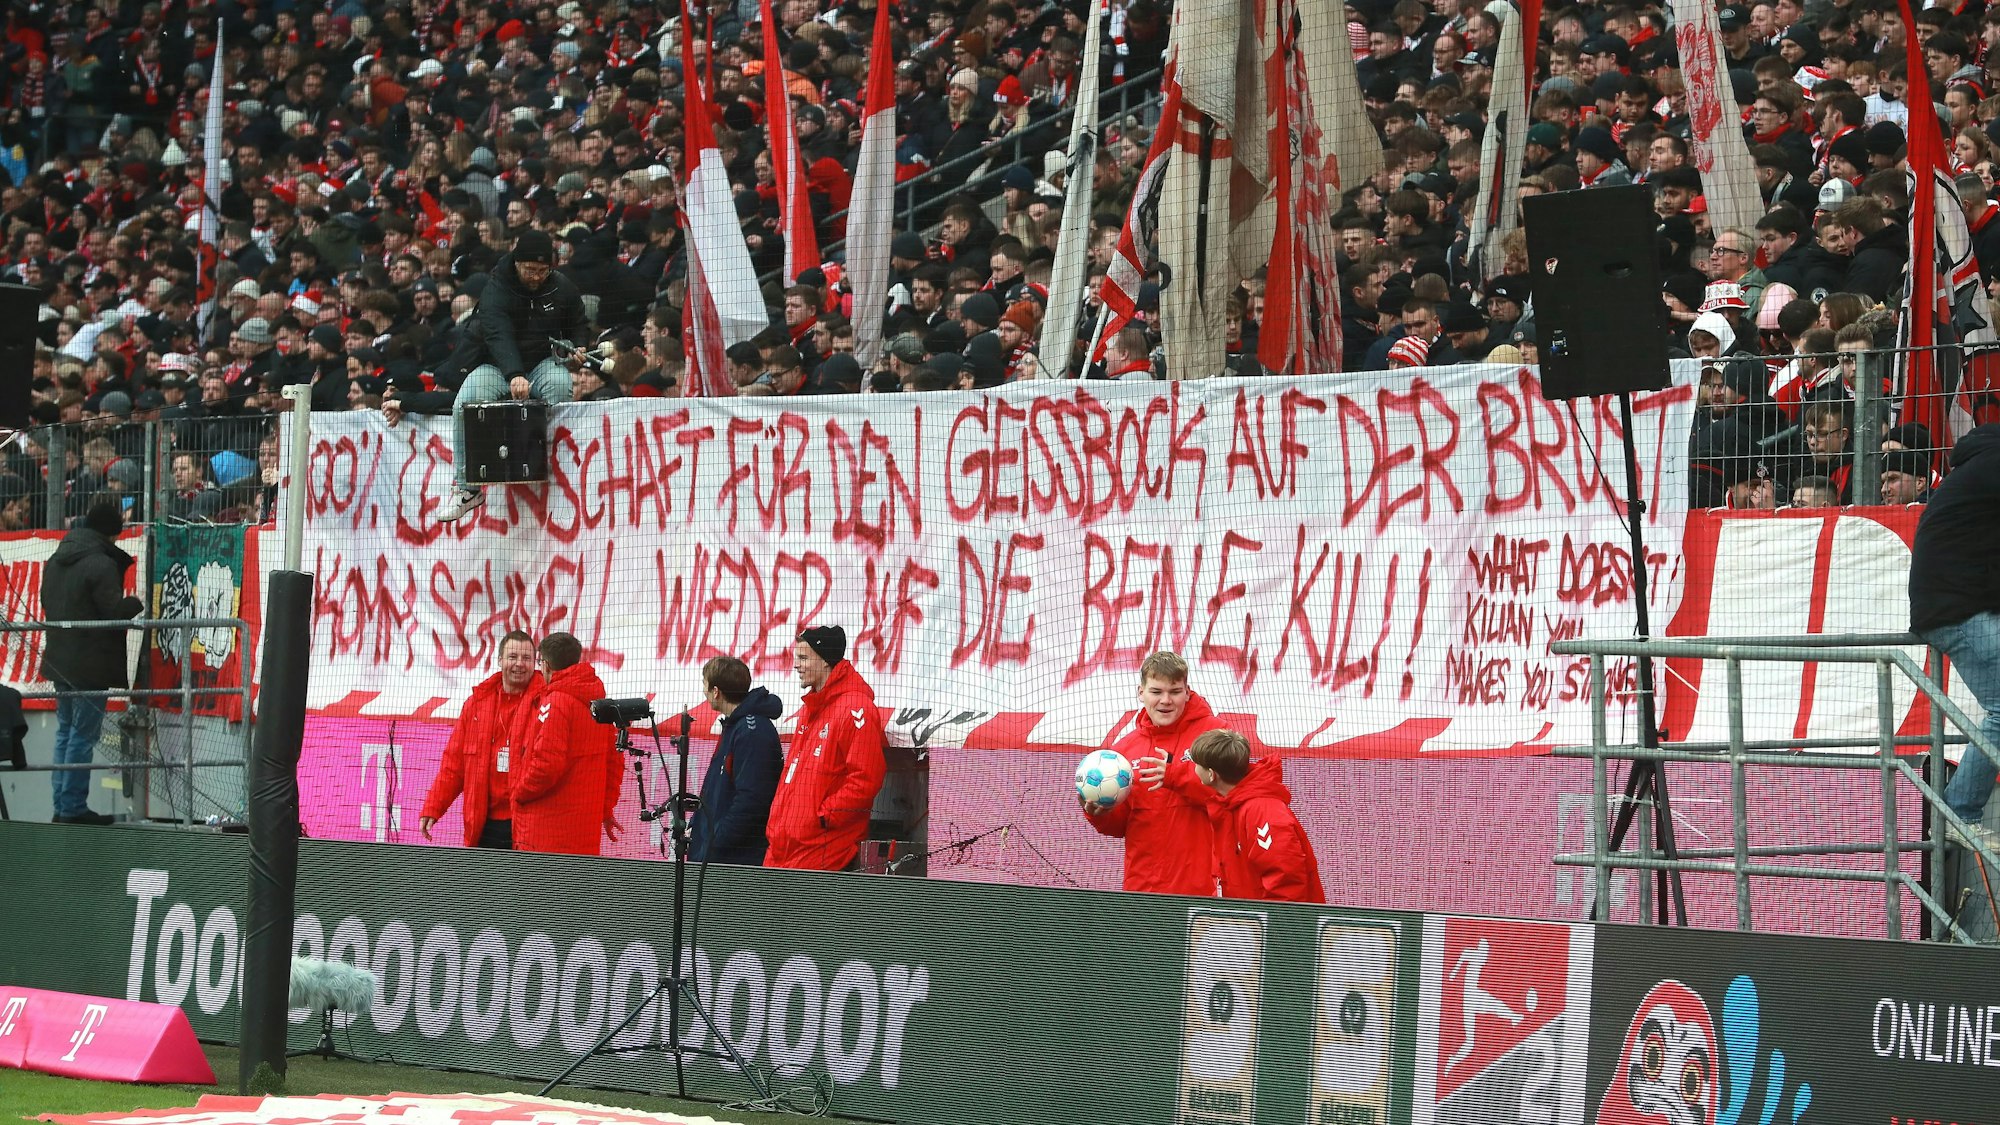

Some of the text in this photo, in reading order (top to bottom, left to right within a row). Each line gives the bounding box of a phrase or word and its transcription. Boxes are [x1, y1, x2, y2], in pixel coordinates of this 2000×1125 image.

[719, 411, 812, 535] FÜR
[825, 405, 922, 555] DEN
[944, 380, 1206, 526] GEISSBOCK
[1228, 386, 1327, 500] AUF
[1335, 376, 1464, 535] DER
[1477, 367, 1692, 526] BRUST
[1468, 532, 1550, 596] WHAT
[950, 531, 1045, 669] DIE
[1463, 591, 1534, 650] KILIAN
[1444, 644, 1511, 706] MAKES
[1520, 660, 1554, 712] YOU
[1872, 997, 2000, 1067] ONLINE
